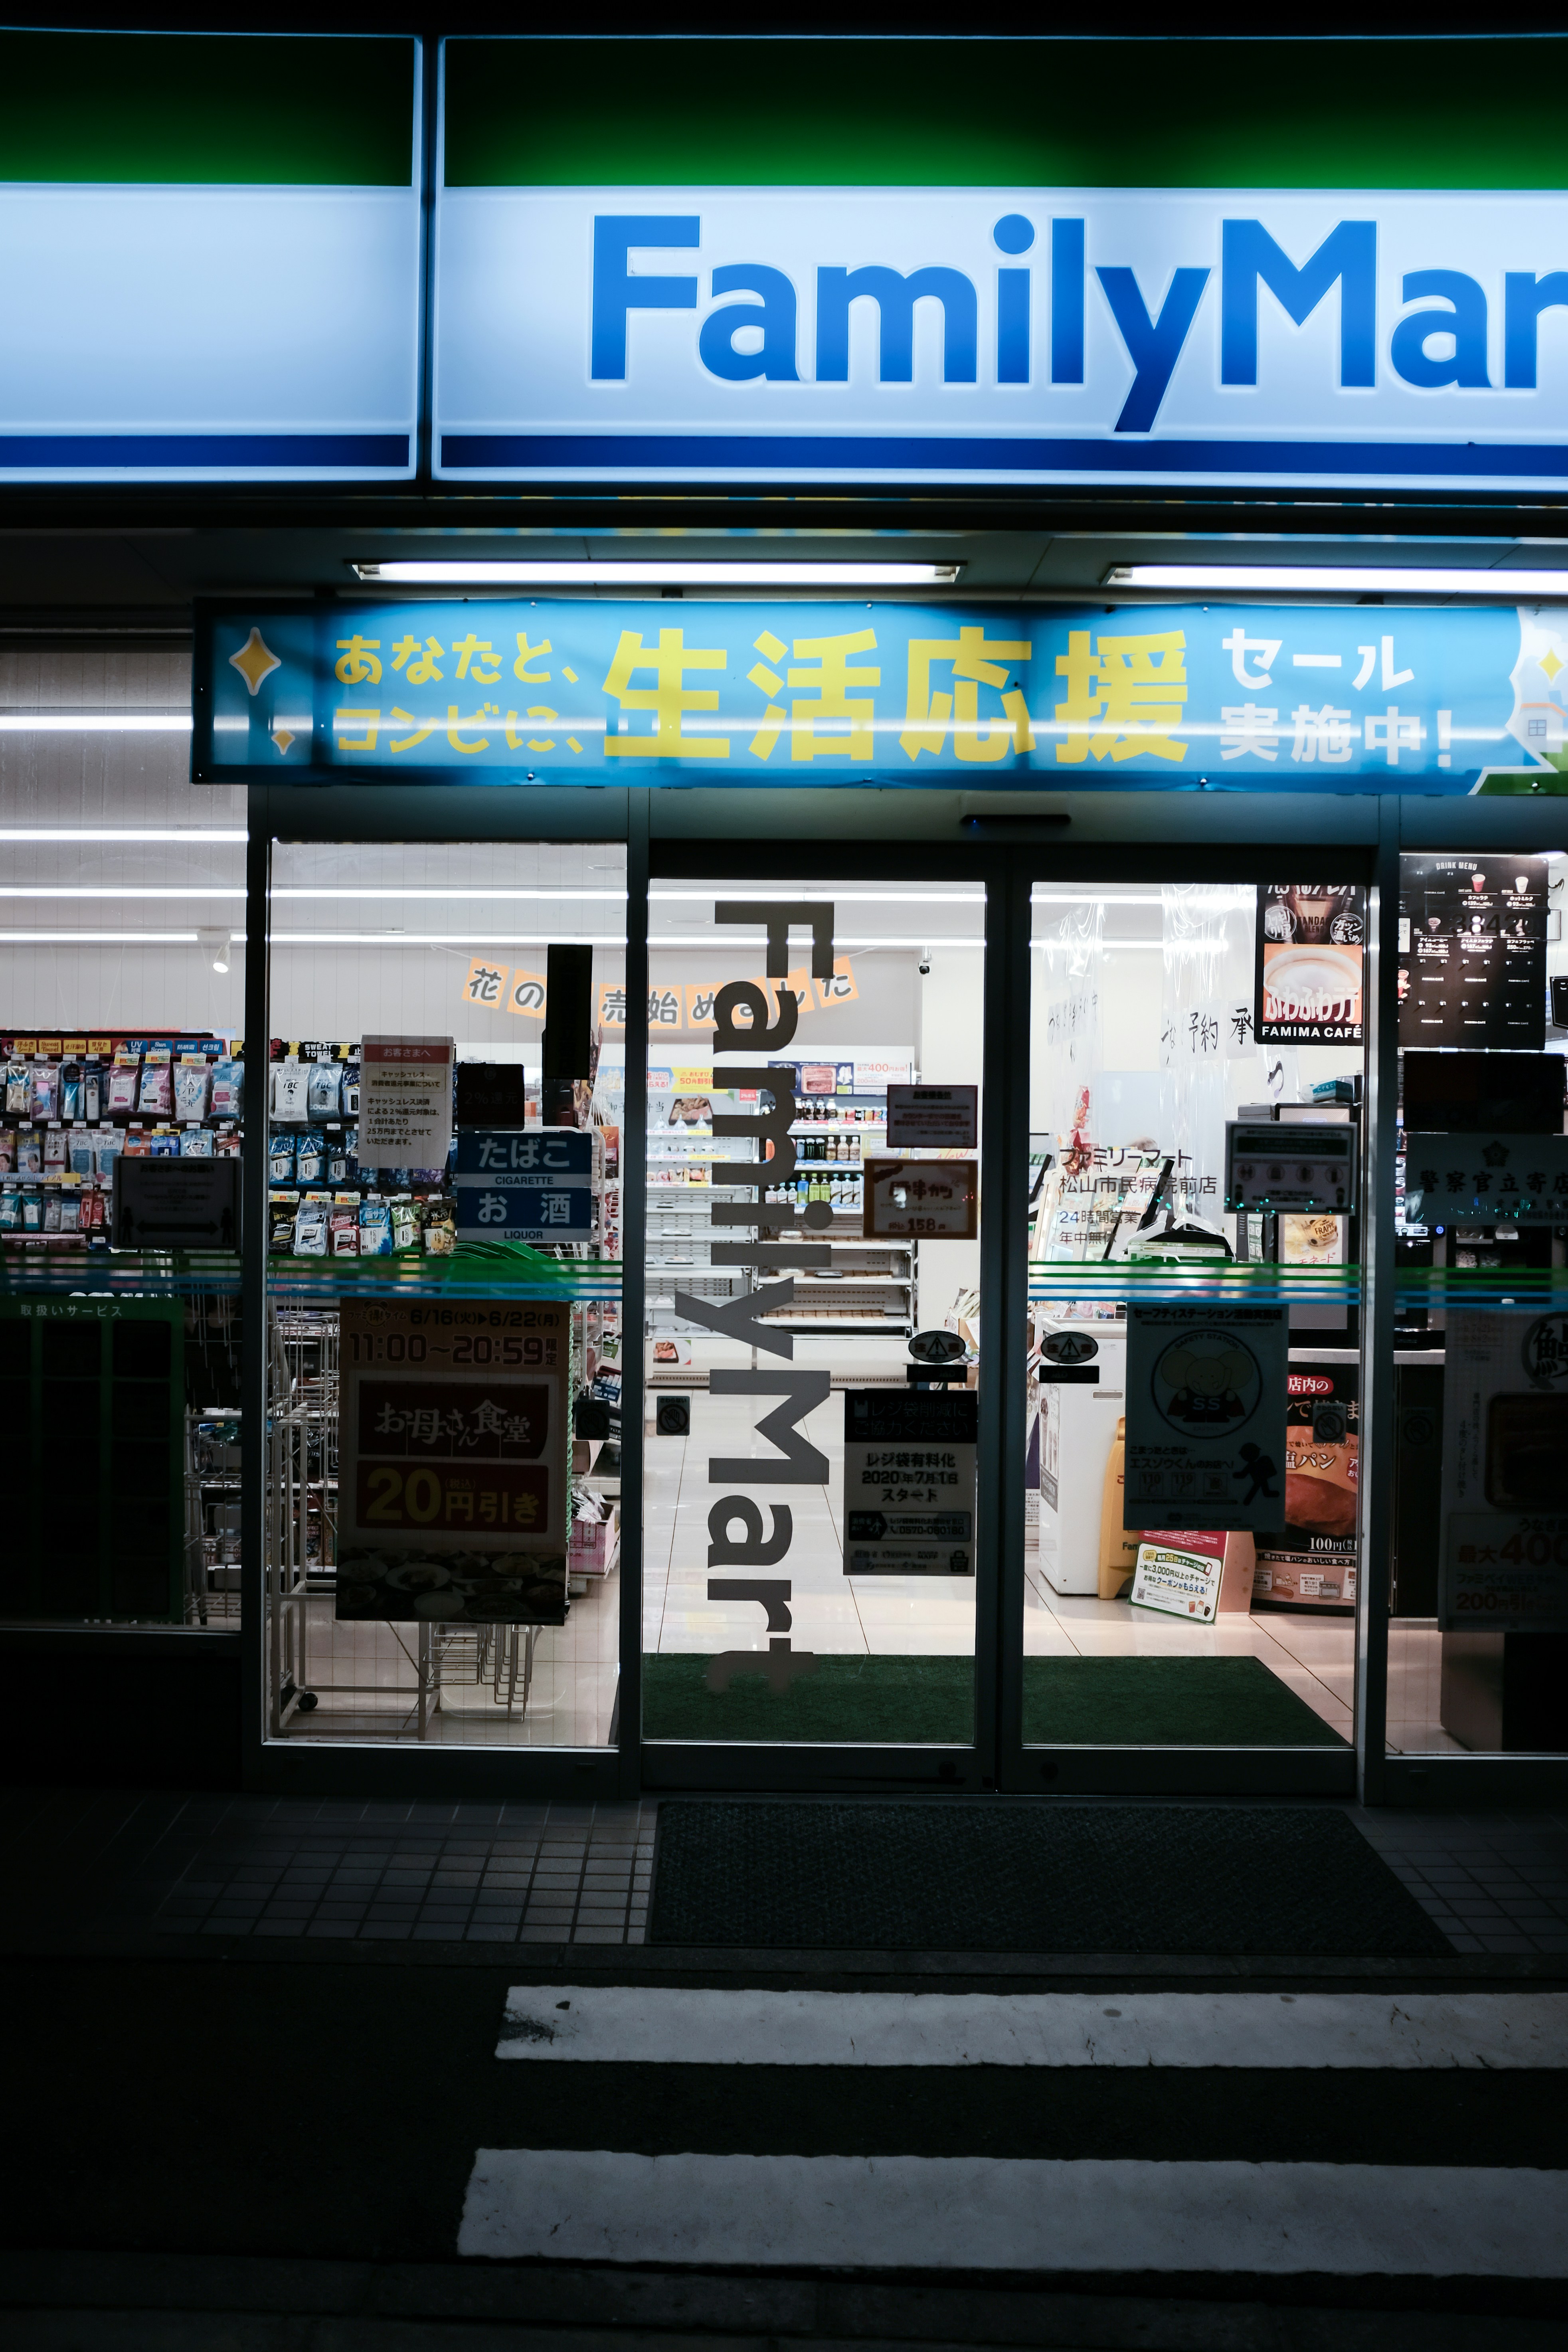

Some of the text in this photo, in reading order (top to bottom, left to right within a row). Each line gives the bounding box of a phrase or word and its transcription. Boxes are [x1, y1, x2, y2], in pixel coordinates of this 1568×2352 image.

[335, 632, 579, 684] あなたと、
[1222, 628, 1415, 691] セール
[602, 626, 1189, 763] 生活応援
[336, 702, 584, 754] コンビに、
[1220, 703, 1452, 768] 実施中!
[1458, 862, 1477, 870] MENU
[1265, 986, 1359, 1022] ふわふわラテ
[1262, 1025, 1362, 1039] FAMIMA CAFÉ
[384, 1048, 431, 1057] お客さまへ
[479, 1138, 570, 1169] たばこ
[1060, 1148, 1192, 1168] ファミリーマート
[495, 1176, 554, 1185] CIGARETTE
[1059, 1175, 1217, 1194] 松山市民病院前店
[479, 1193, 570, 1224] お酒
[908, 1219, 945, 1231] 158円
[1060, 1211, 1140, 1224] 24時間営業
[504, 1230, 543, 1240] LIQUOR
[1059, 1231, 1117, 1244] 年中無休
[674, 901, 834, 1691] FamilyMart
[20, 1304, 123, 1317] 取扱いサービス
[410, 1309, 479, 1326] 6/16(火)
[489, 1310, 559, 1327] 6/22(月)
[1175, 1333, 1240, 1349] SAFETY STATION
[546, 1337, 558, 1367] 限定
[1288, 1377, 1329, 1392] 店内の
[872, 1401, 968, 1418] レジ袋削減に
[1192, 1397, 1221, 1411] SS
[374, 1399, 532, 1447] お母さん食堂
[854, 1420, 968, 1436] ご協力ください
[866, 1452, 956, 1468] レジ袋有料化
[445, 1479, 477, 1490] (税込)
[862, 1472, 958, 1484] 2020年7月1日
[1142, 1474, 1161, 1484] 110
[1175, 1474, 1193, 1484] 119
[366, 1468, 541, 1524] 20円引き
[882, 1488, 938, 1502] スタート
[1140, 1565, 1215, 1586] 一度に3,000円以上のチャージで
